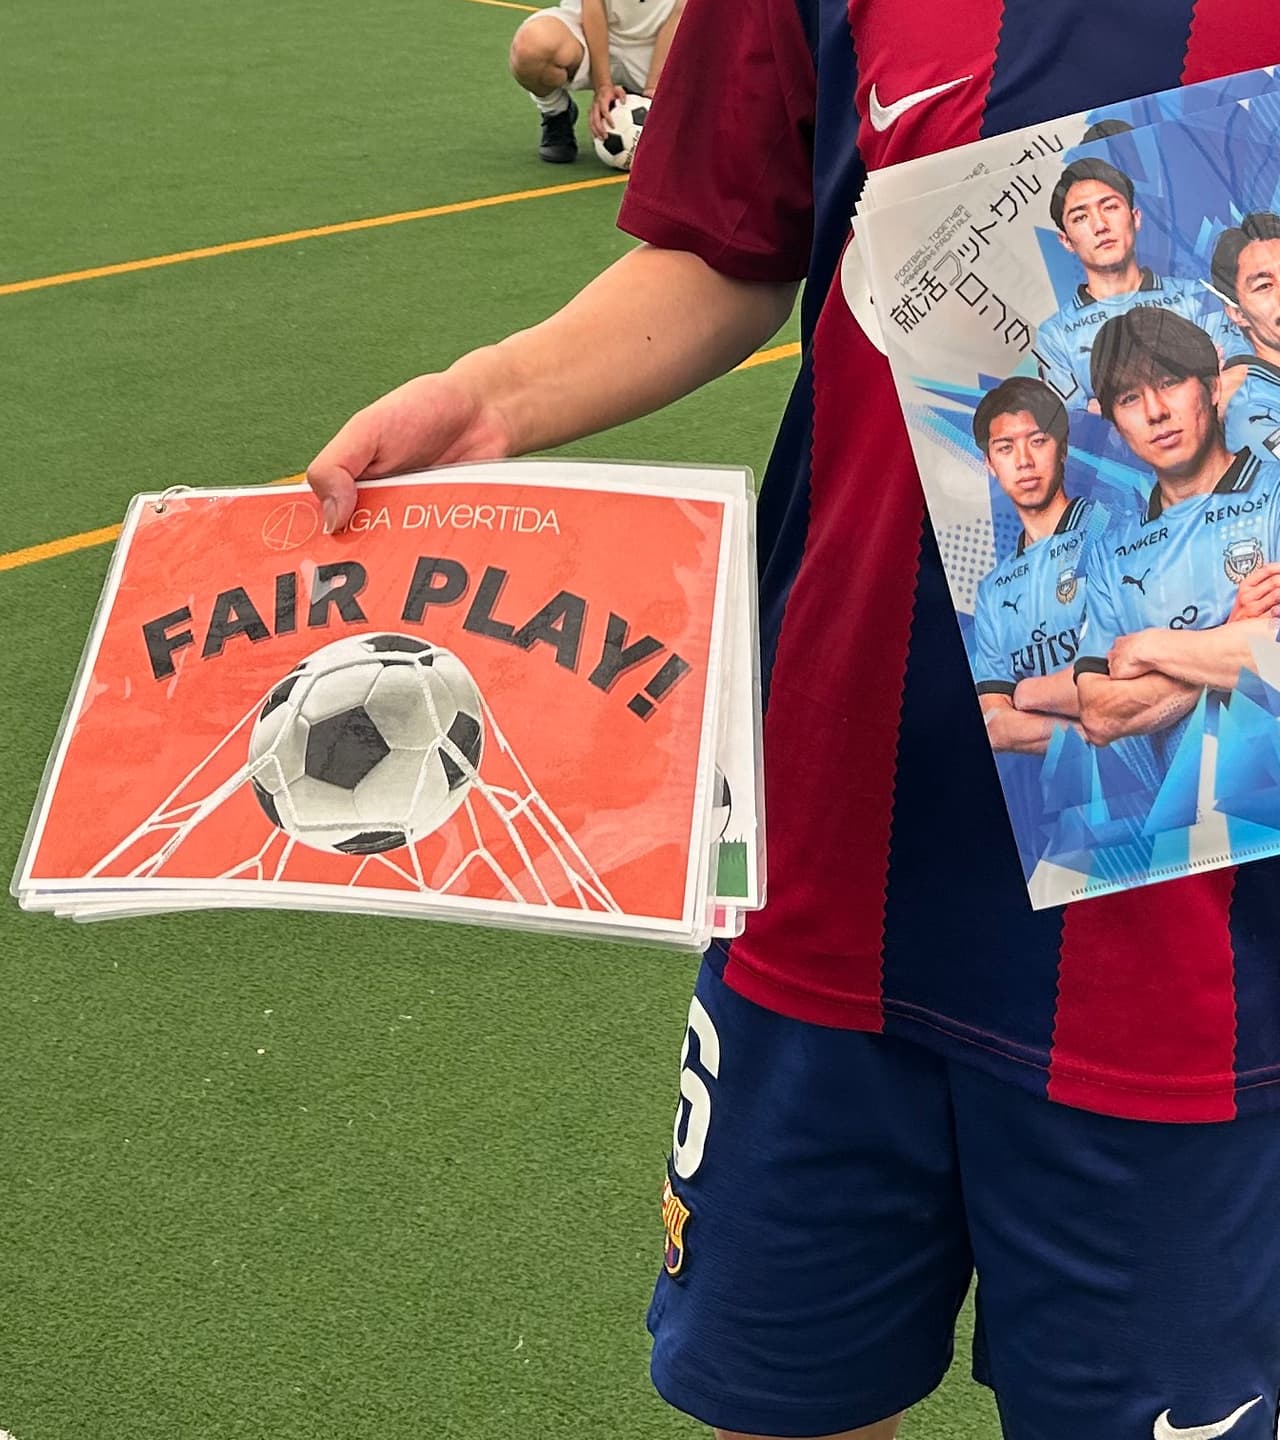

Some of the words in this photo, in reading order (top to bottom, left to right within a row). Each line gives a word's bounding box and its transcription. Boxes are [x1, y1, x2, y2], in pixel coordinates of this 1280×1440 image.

[894, 244, 931, 282] FOOTBALL
[928, 204, 966, 242] TOGETHER
[323, 506, 392, 535] GA
[1205, 491, 1271, 525] RENOSY
[1114, 527, 1169, 557] ANKER
[141, 560, 370, 683] FAIR
[401, 555, 692, 723] PLAY!
